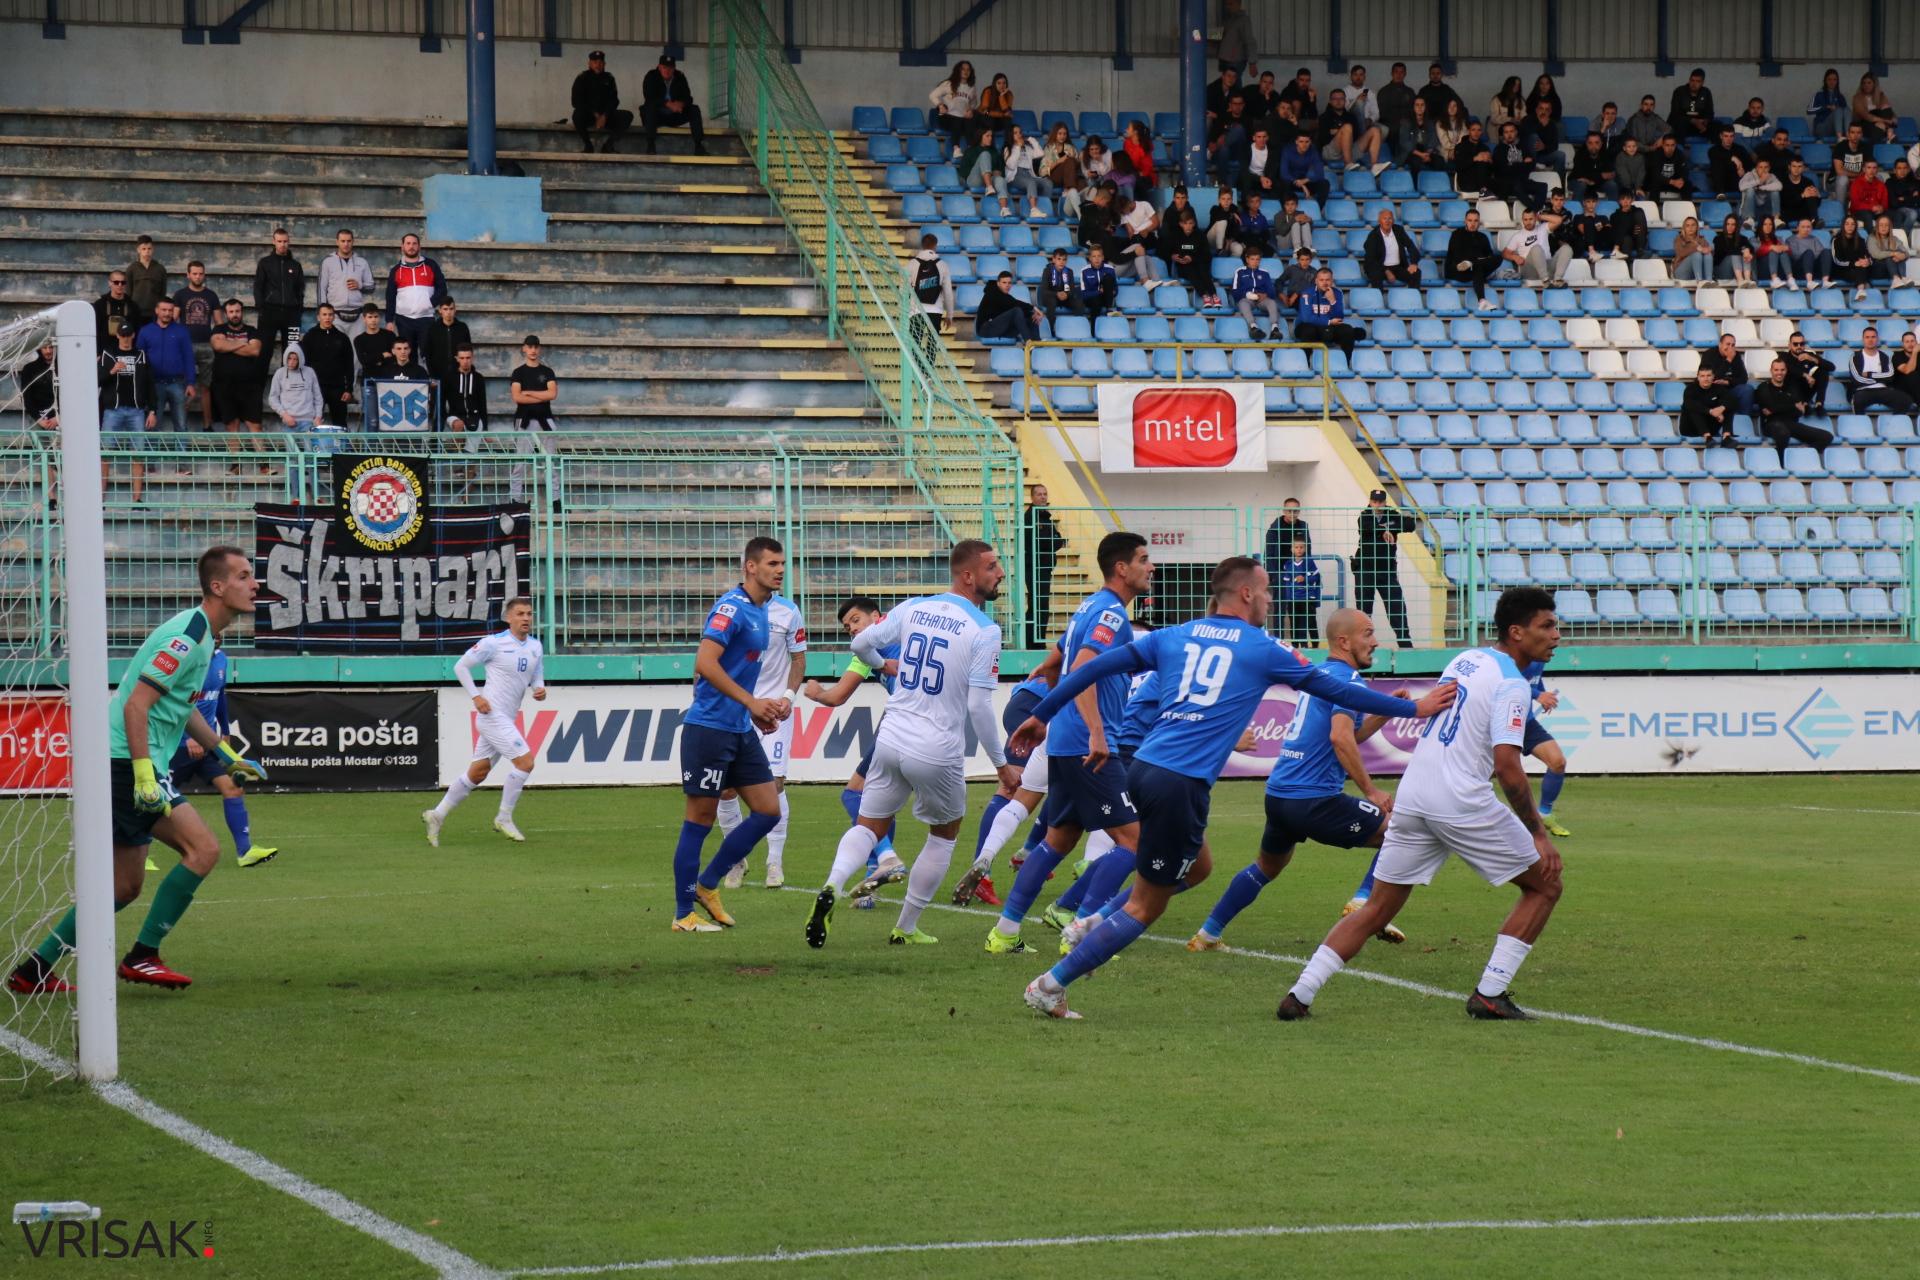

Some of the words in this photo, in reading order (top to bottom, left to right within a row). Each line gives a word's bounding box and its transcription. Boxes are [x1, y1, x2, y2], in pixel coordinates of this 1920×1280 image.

[379, 389, 429, 428] 96
[1144, 411, 1225, 441] m:tel
[341, 478, 354, 499] POD
[351, 457, 384, 479] SVETIM
[344, 516, 356, 530] DO
[1151, 532, 1184, 545] EXIT
[910, 610, 967, 636] MEHANOVIĆ
[1192, 624, 1242, 643] VUKOJA
[170, 639, 189, 652] EP
[516, 657, 528, 672] 18
[900, 632, 949, 696] 95
[1174, 643, 1233, 707] 19
[261, 721, 328, 747] Brza
[338, 719, 419, 752] pošta
[1601, 711, 1777, 738] EMERUS
[261, 757, 308, 767] Hrvatska
[311, 755, 342, 768] pošta
[344, 756, 382, 766] Mostar
[392, 755, 418, 765] 1323
[773, 741, 784, 760] 8
[699, 767, 723, 791] 24
[1358, 800, 1380, 817] 9
